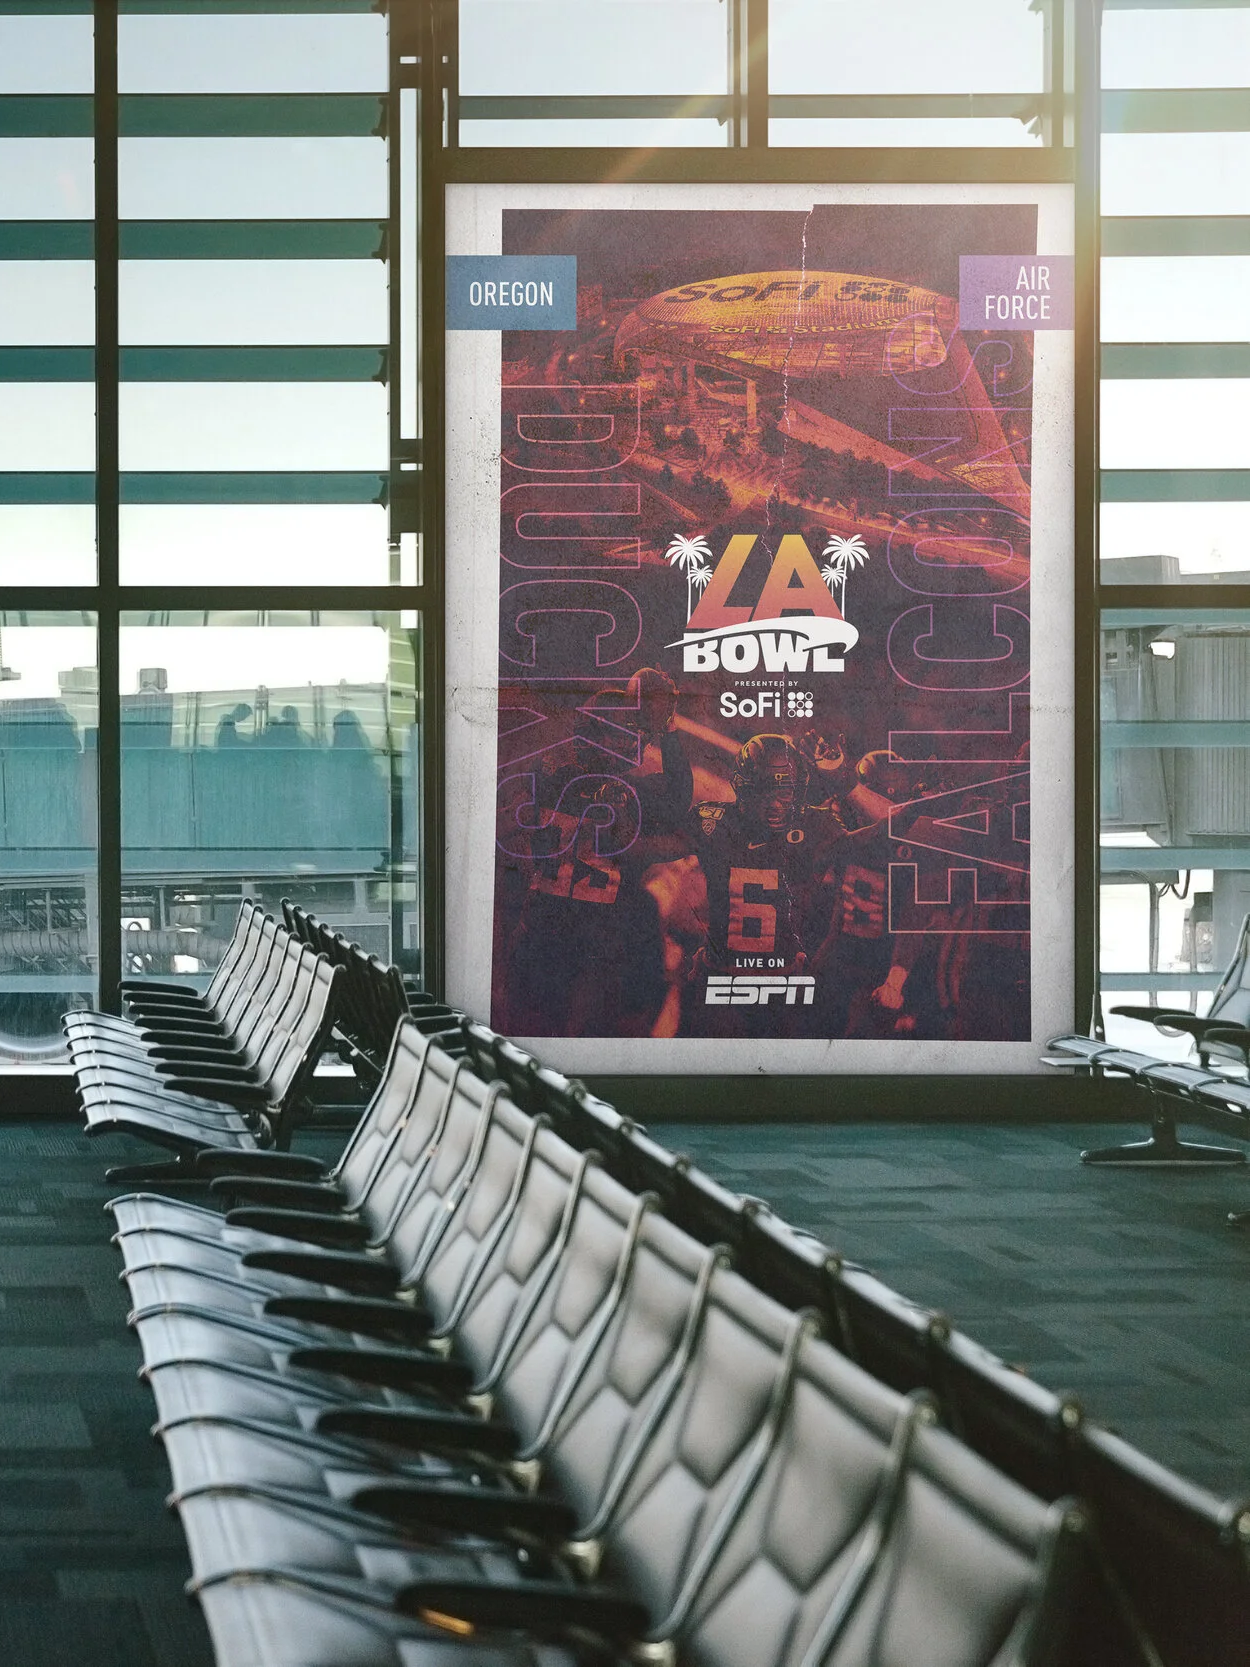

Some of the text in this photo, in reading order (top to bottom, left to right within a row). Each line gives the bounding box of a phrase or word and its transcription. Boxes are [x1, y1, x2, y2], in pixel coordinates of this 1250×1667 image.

[1015, 265, 1051, 291] AIR
[469, 281, 554, 307] OREGON
[984, 294, 1051, 320] FORCE
[793, 316, 900, 334] Stadium
[685, 533, 846, 630] LA
[495, 385, 643, 859] DUCKS
[888, 311, 1032, 934] FALCONS
[682, 632, 845, 674] BOWL
[734, 680, 799, 688] PRESENTED BY
[719, 690, 781, 719] SoFi
[726, 867, 779, 953] 6
[735, 958, 786, 968] LIVE ON
[704, 975, 817, 1005] ESPN
